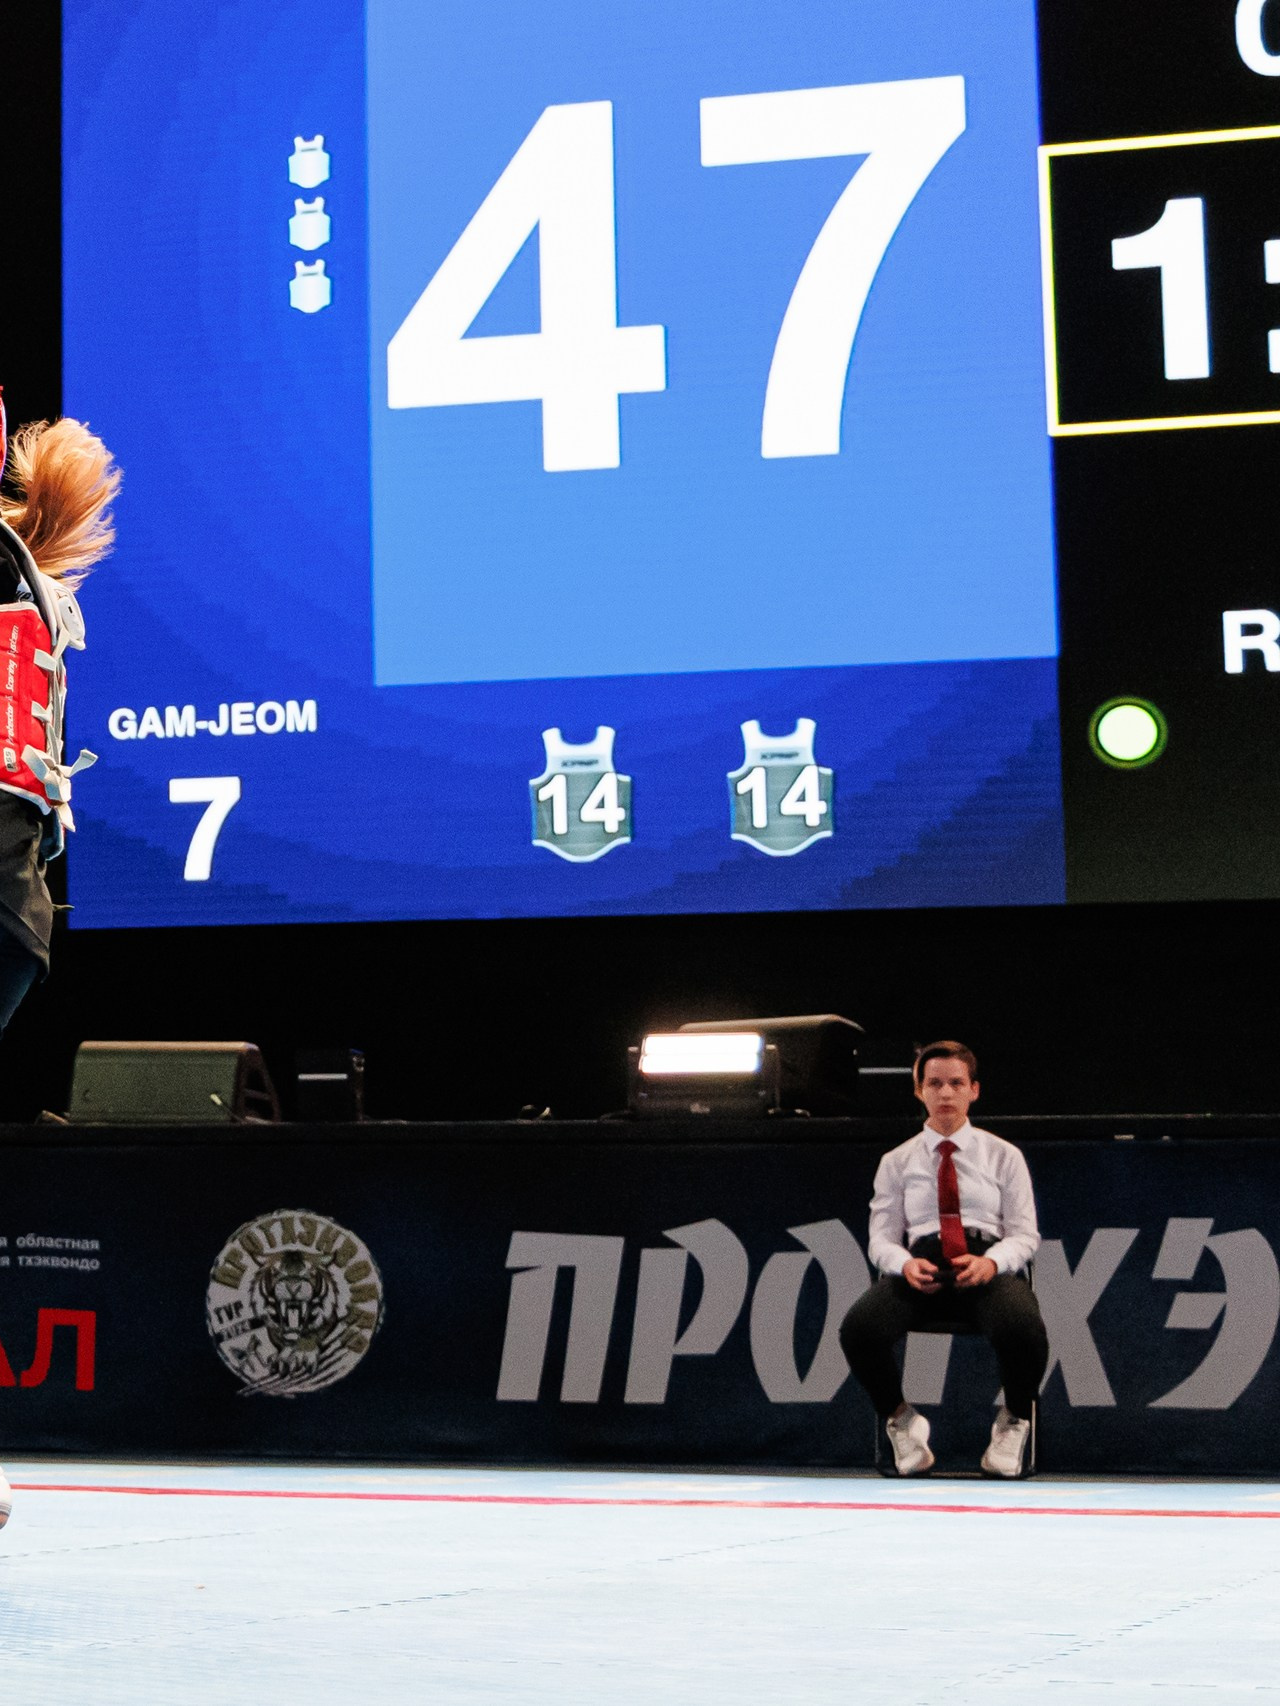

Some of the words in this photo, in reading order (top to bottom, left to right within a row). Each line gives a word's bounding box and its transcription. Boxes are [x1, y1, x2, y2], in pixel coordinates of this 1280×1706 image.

[386, 75, 965, 472] 47
[5, 659, 18, 692] Scoring
[108, 699, 317, 740] GAM-JEOM
[169, 776, 241, 880] 7
[538, 772, 626, 835] 14
[736, 765, 827, 828] 14
[16, 1232, 100, 1250] областная
[18, 1255, 101, 1271] тхэквондо
[496, 1217, 1280, 1410] ПРОХЭ
